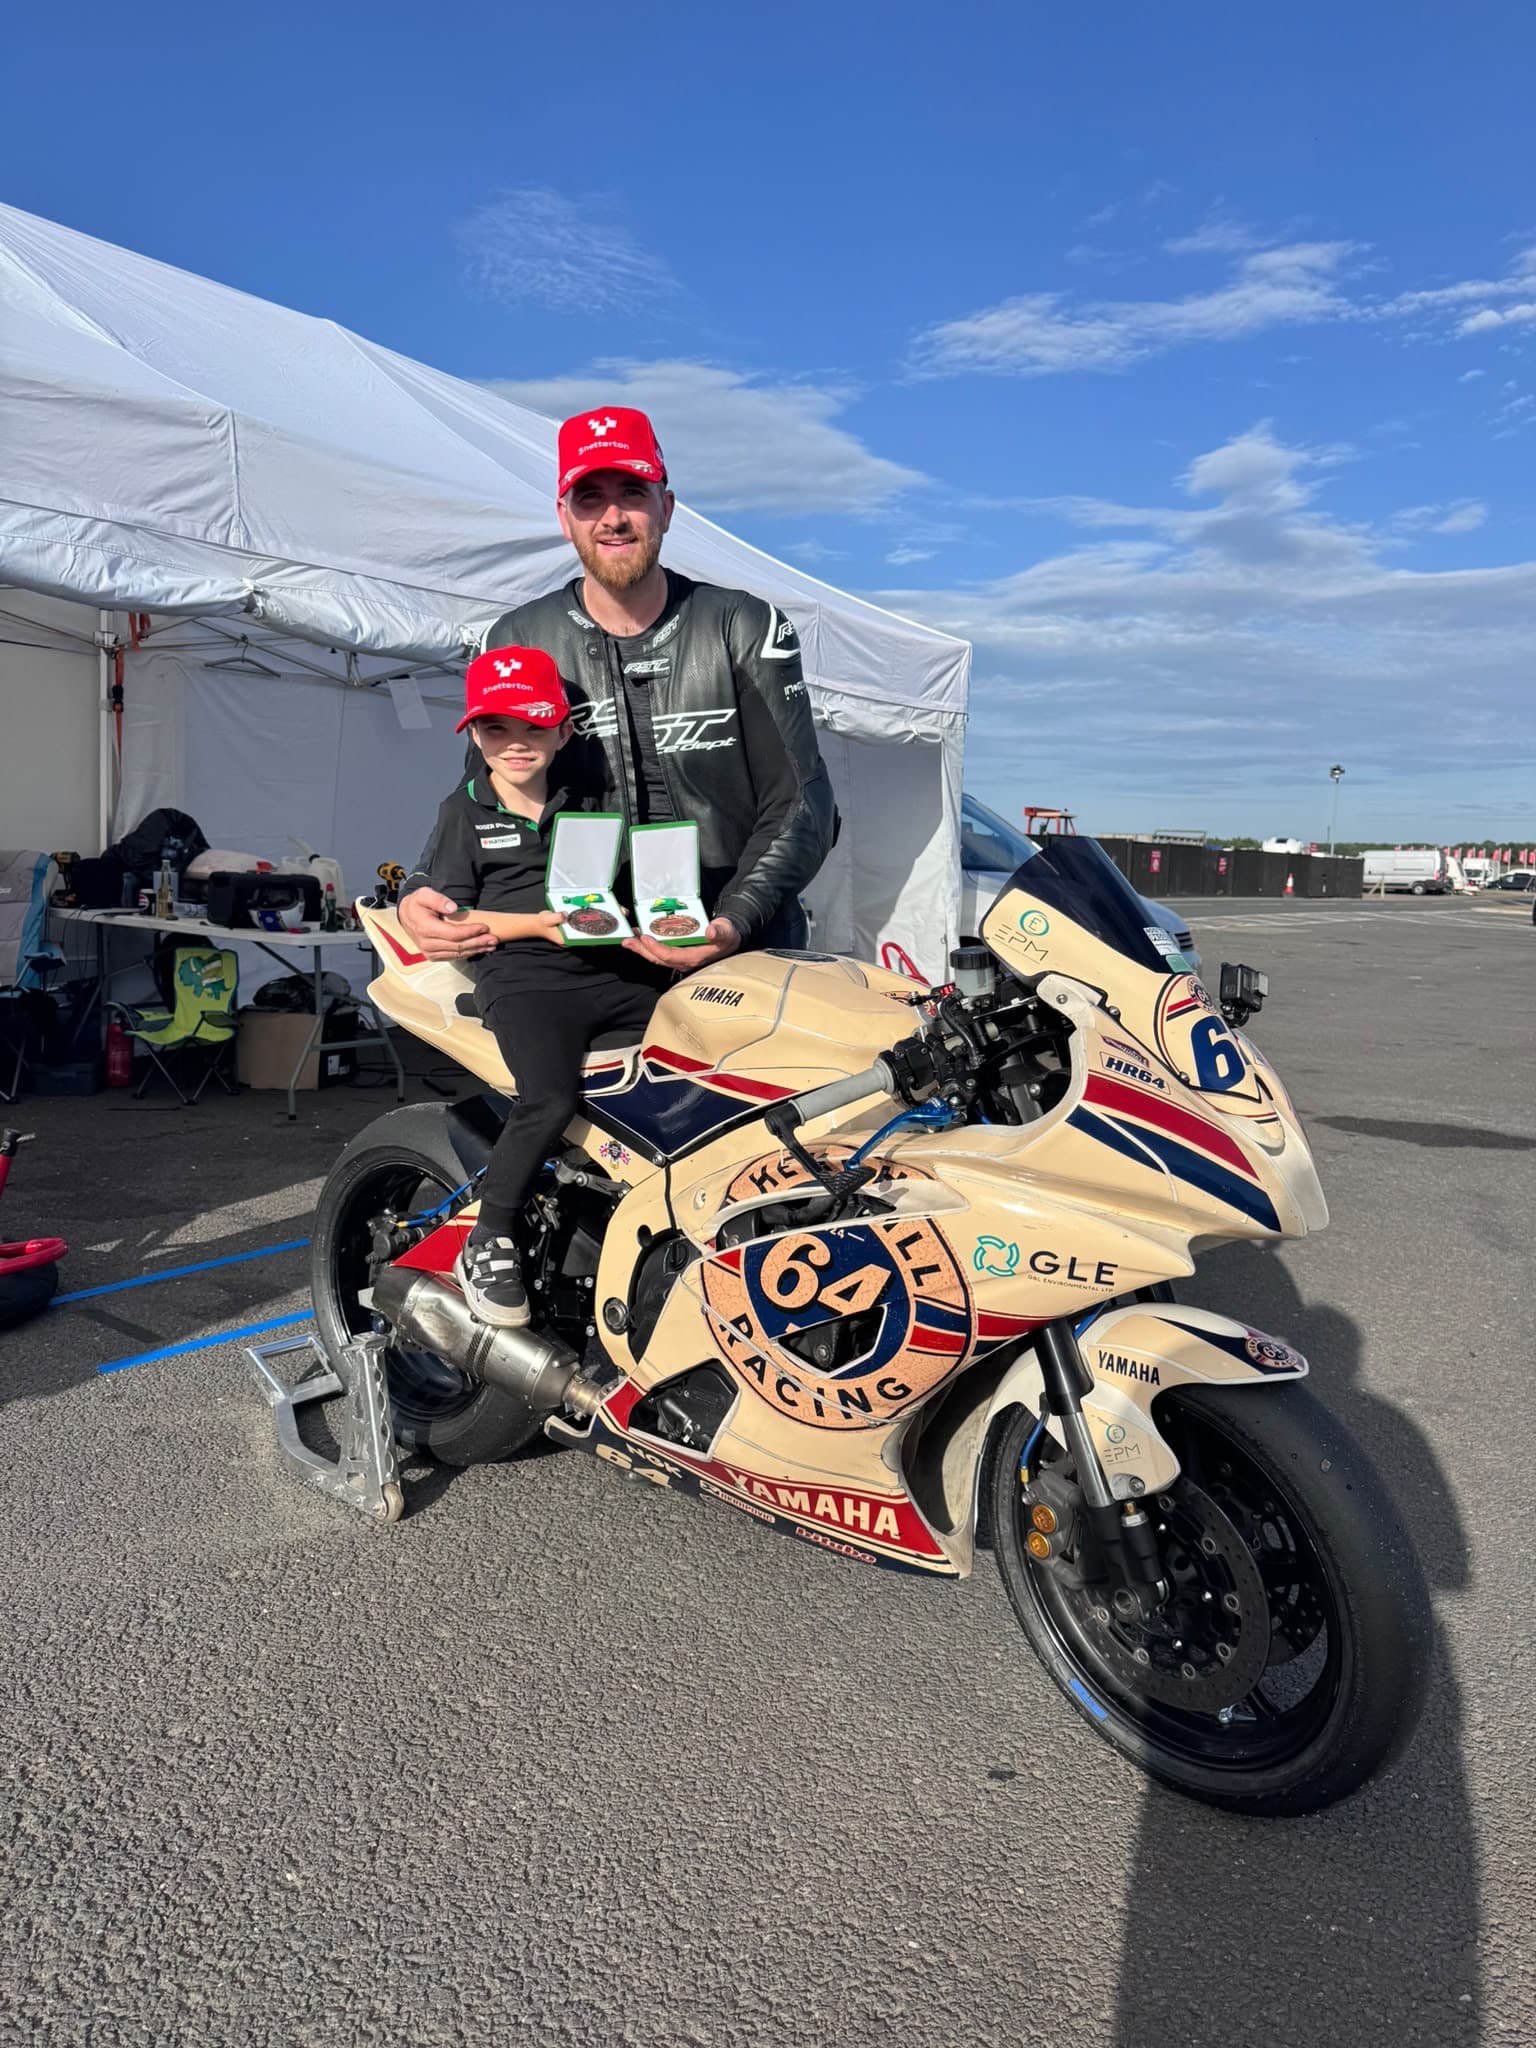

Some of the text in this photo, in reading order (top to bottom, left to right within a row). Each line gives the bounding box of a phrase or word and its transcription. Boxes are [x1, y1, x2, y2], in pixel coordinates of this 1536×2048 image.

[994, 923, 1049, 961] EPM
[690, 986, 745, 1007] YAMAHA
[1105, 1056, 1166, 1090] HR64
[760, 1233, 893, 1316] 64
[1029, 1251, 1119, 1286] GLE
[1043, 1278, 1100, 1292] ENVIRONMENTAL
[718, 1316, 912, 1419] RACING
[1098, 1350, 1161, 1386] YAMAHA
[595, 1443, 673, 1489] 64
[1103, 1443, 1141, 1463] EPM
[723, 1468, 901, 1540] YAMAHA
